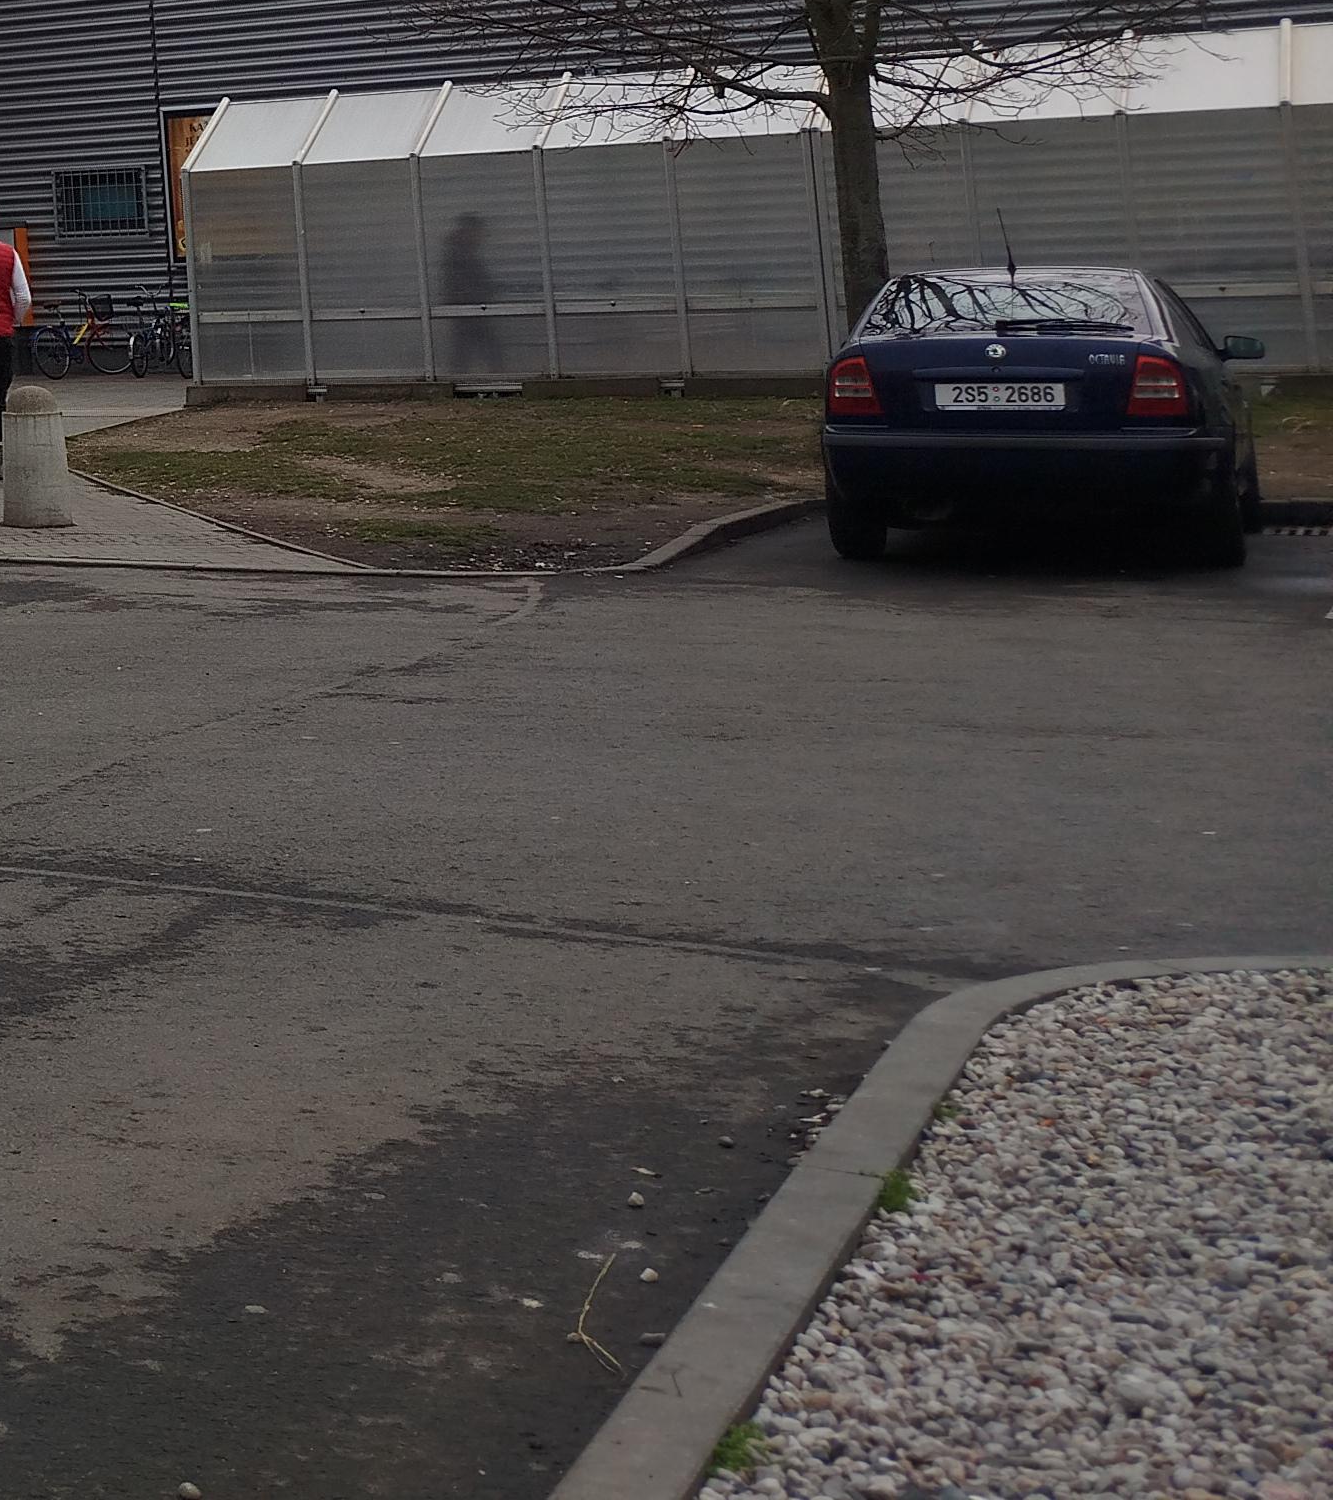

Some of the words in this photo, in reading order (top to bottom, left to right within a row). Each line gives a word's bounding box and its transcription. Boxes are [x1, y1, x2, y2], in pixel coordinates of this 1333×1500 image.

[1088, 353, 1126, 366] OCTAVIA
[951, 386, 989, 404] 2S5
[1004, 386, 1055, 404] 2686
